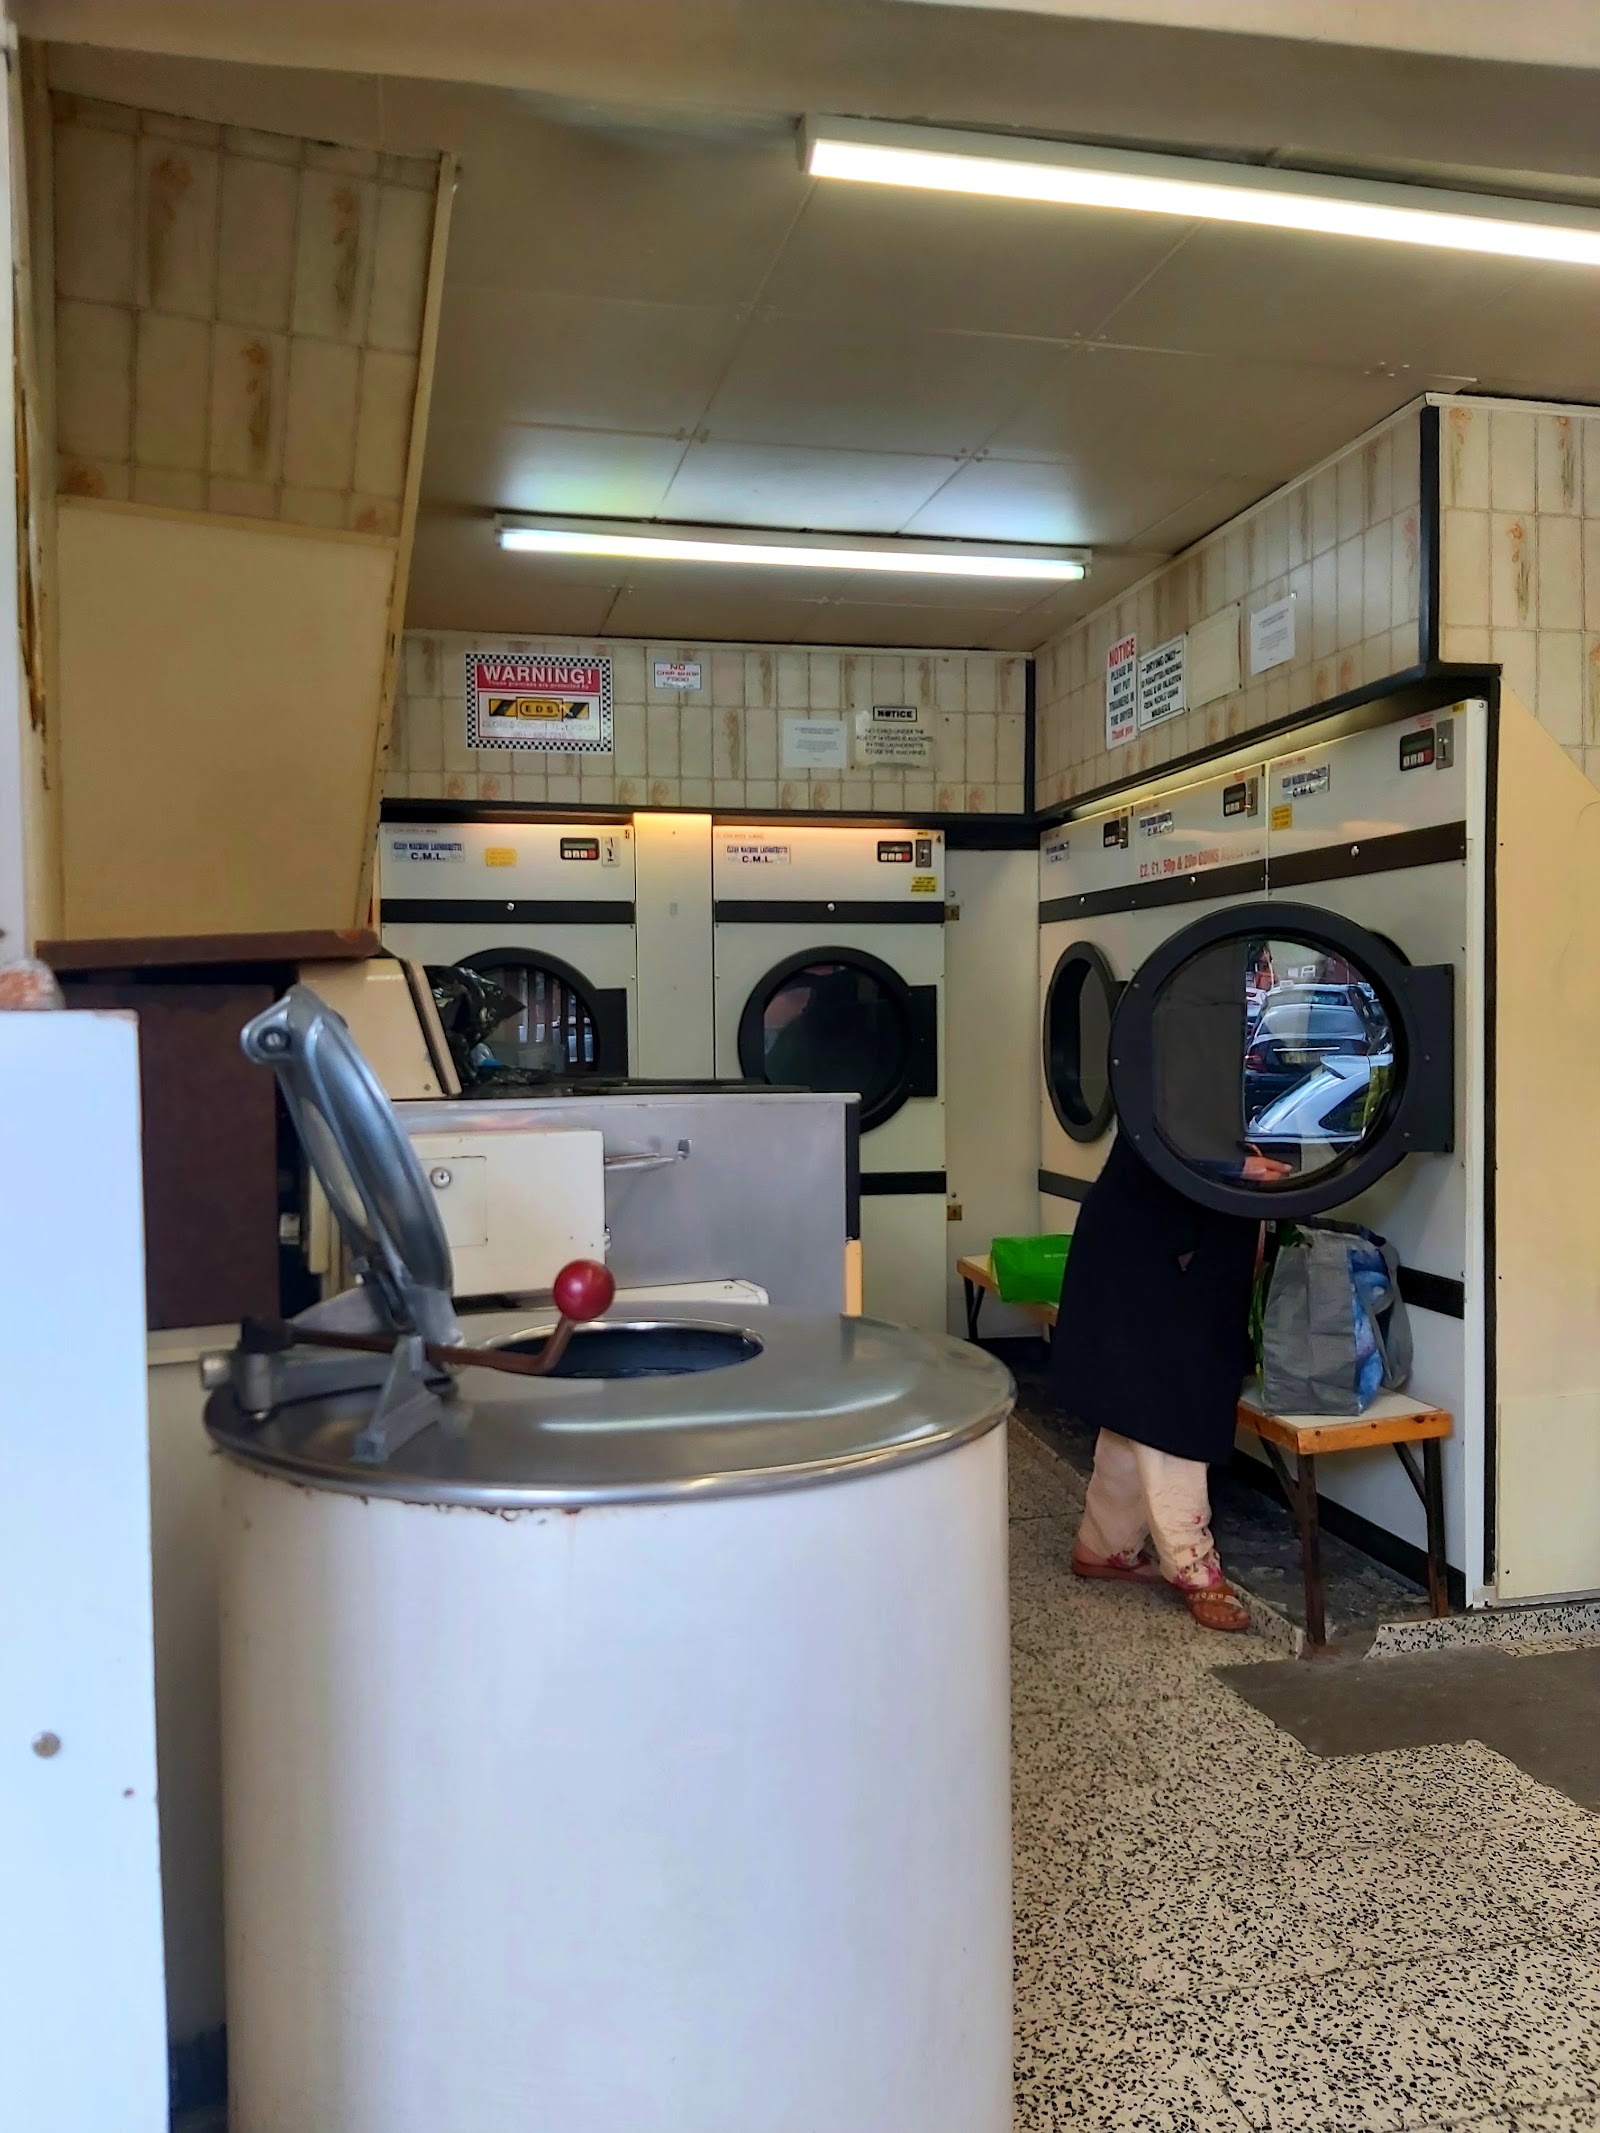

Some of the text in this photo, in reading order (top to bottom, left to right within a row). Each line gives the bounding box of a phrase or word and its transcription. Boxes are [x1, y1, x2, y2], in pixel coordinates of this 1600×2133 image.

[1109, 638, 1134, 668] NOTICE
[482, 664, 593, 685] WARNING!
[1111, 664, 1127, 681] PLEASE
[525, 705, 554, 713] EDS
[877, 710, 913, 718] NOTICE
[411, 853, 446, 861] C.M.L.
[1177, 856, 1182, 870] &
